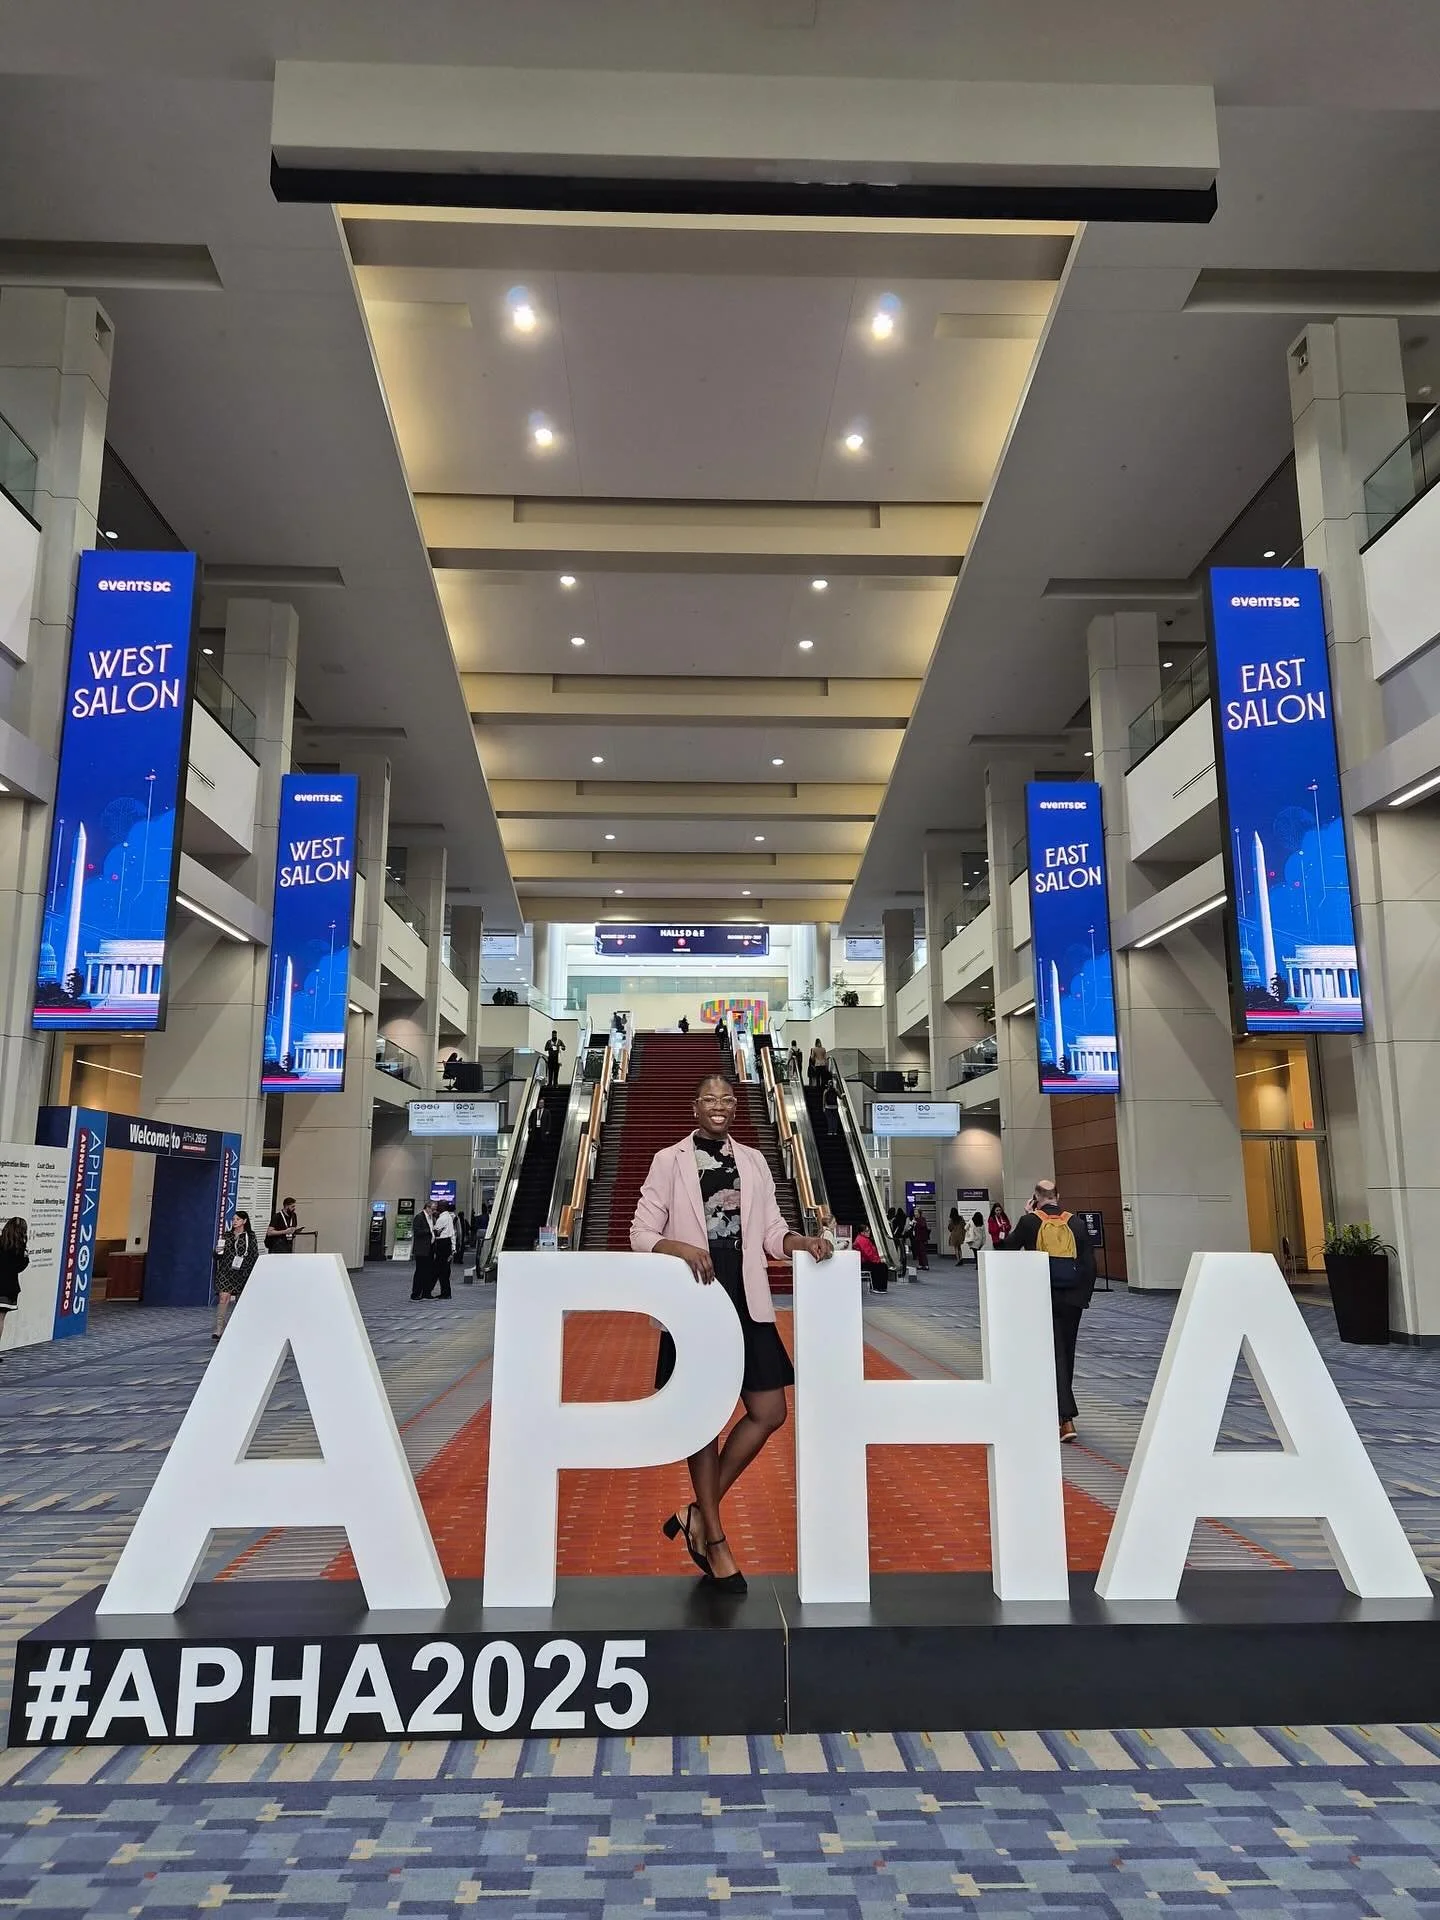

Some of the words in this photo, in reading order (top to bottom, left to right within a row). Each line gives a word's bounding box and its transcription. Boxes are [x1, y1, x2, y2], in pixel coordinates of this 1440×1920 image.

[88, 643, 173, 680] WEST
[1241, 657, 1306, 693] EAST
[72, 678, 180, 718] SALON
[1227, 691, 1326, 731] SALON
[290, 836, 345, 862] WEST
[1046, 843, 1089, 868] EAST
[280, 860, 350, 887] SALON
[1035, 866, 1102, 893] SALON
[660, 929, 684, 937] HALLS
[686, 929, 692, 937] D
[692, 929, 699, 937] &
[700, 929, 705, 937] E
[130, 1124, 170, 1148] Welcome
[171, 1131, 180, 1149] to
[75, 1134, 87, 1190] ANNUAL
[82, 1131, 102, 1216] APHA
[226, 1150, 238, 1213] APHA
[68, 1193, 81, 1254] MEETING
[67, 1257, 74, 1268] &
[72, 1224, 92, 1314] 2025
[63, 1272, 72, 1310] EXPO
[95, 1249, 1434, 1616] APHA
[25, 1639, 650, 1741] #APHA2025
